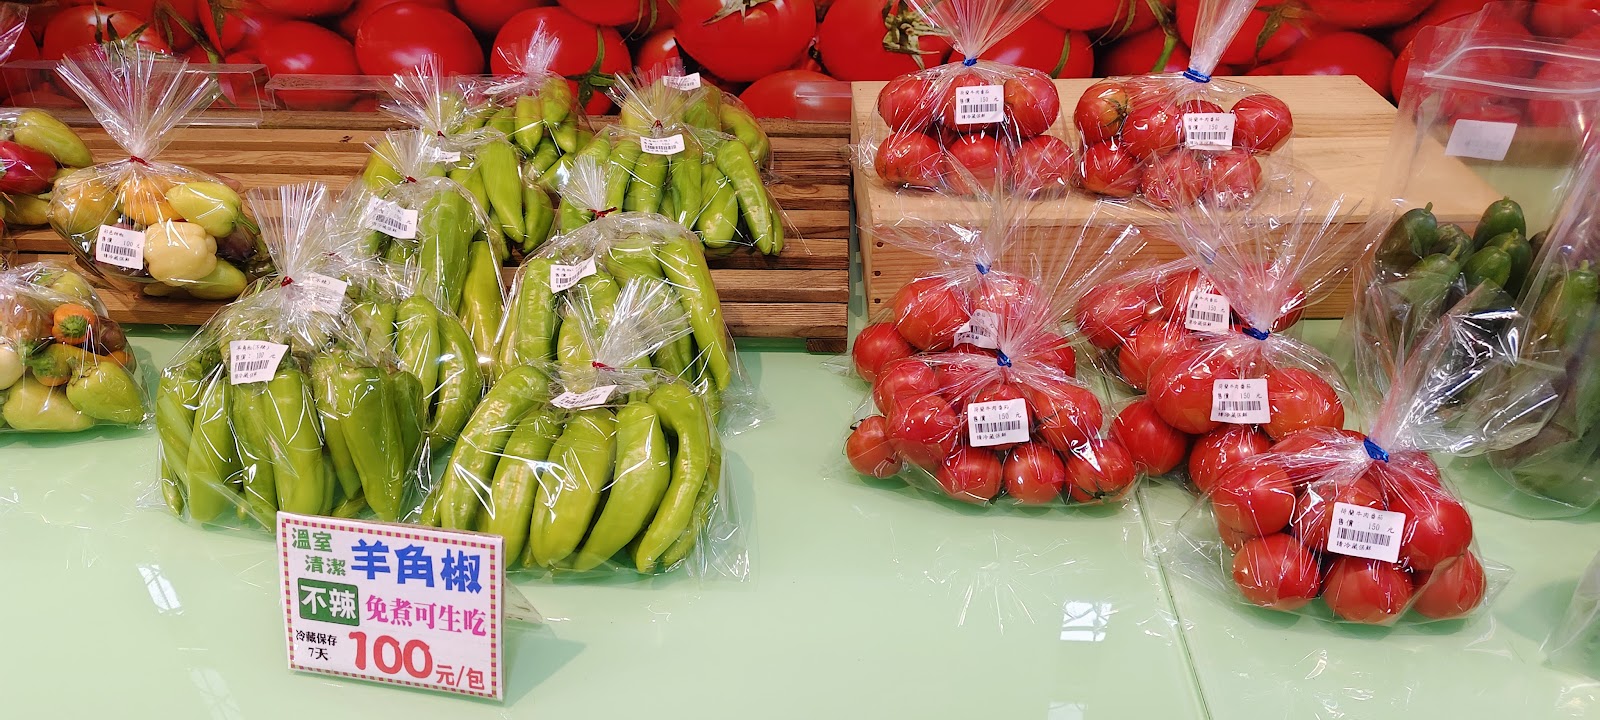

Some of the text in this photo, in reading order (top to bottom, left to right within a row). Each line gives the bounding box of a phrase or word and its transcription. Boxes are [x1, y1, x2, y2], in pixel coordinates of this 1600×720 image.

[1369, 523, 1381, 531] 150
[292, 527, 333, 553] 溫室
[305, 554, 346, 576] 清潔
[351, 539, 482, 594] 羊角椒
[300, 584, 357, 620] 不辣
[366, 594, 487, 637] 免煮可生吃
[296, 630, 337, 646] 冷藏保存
[308, 648, 329, 661] 7天
